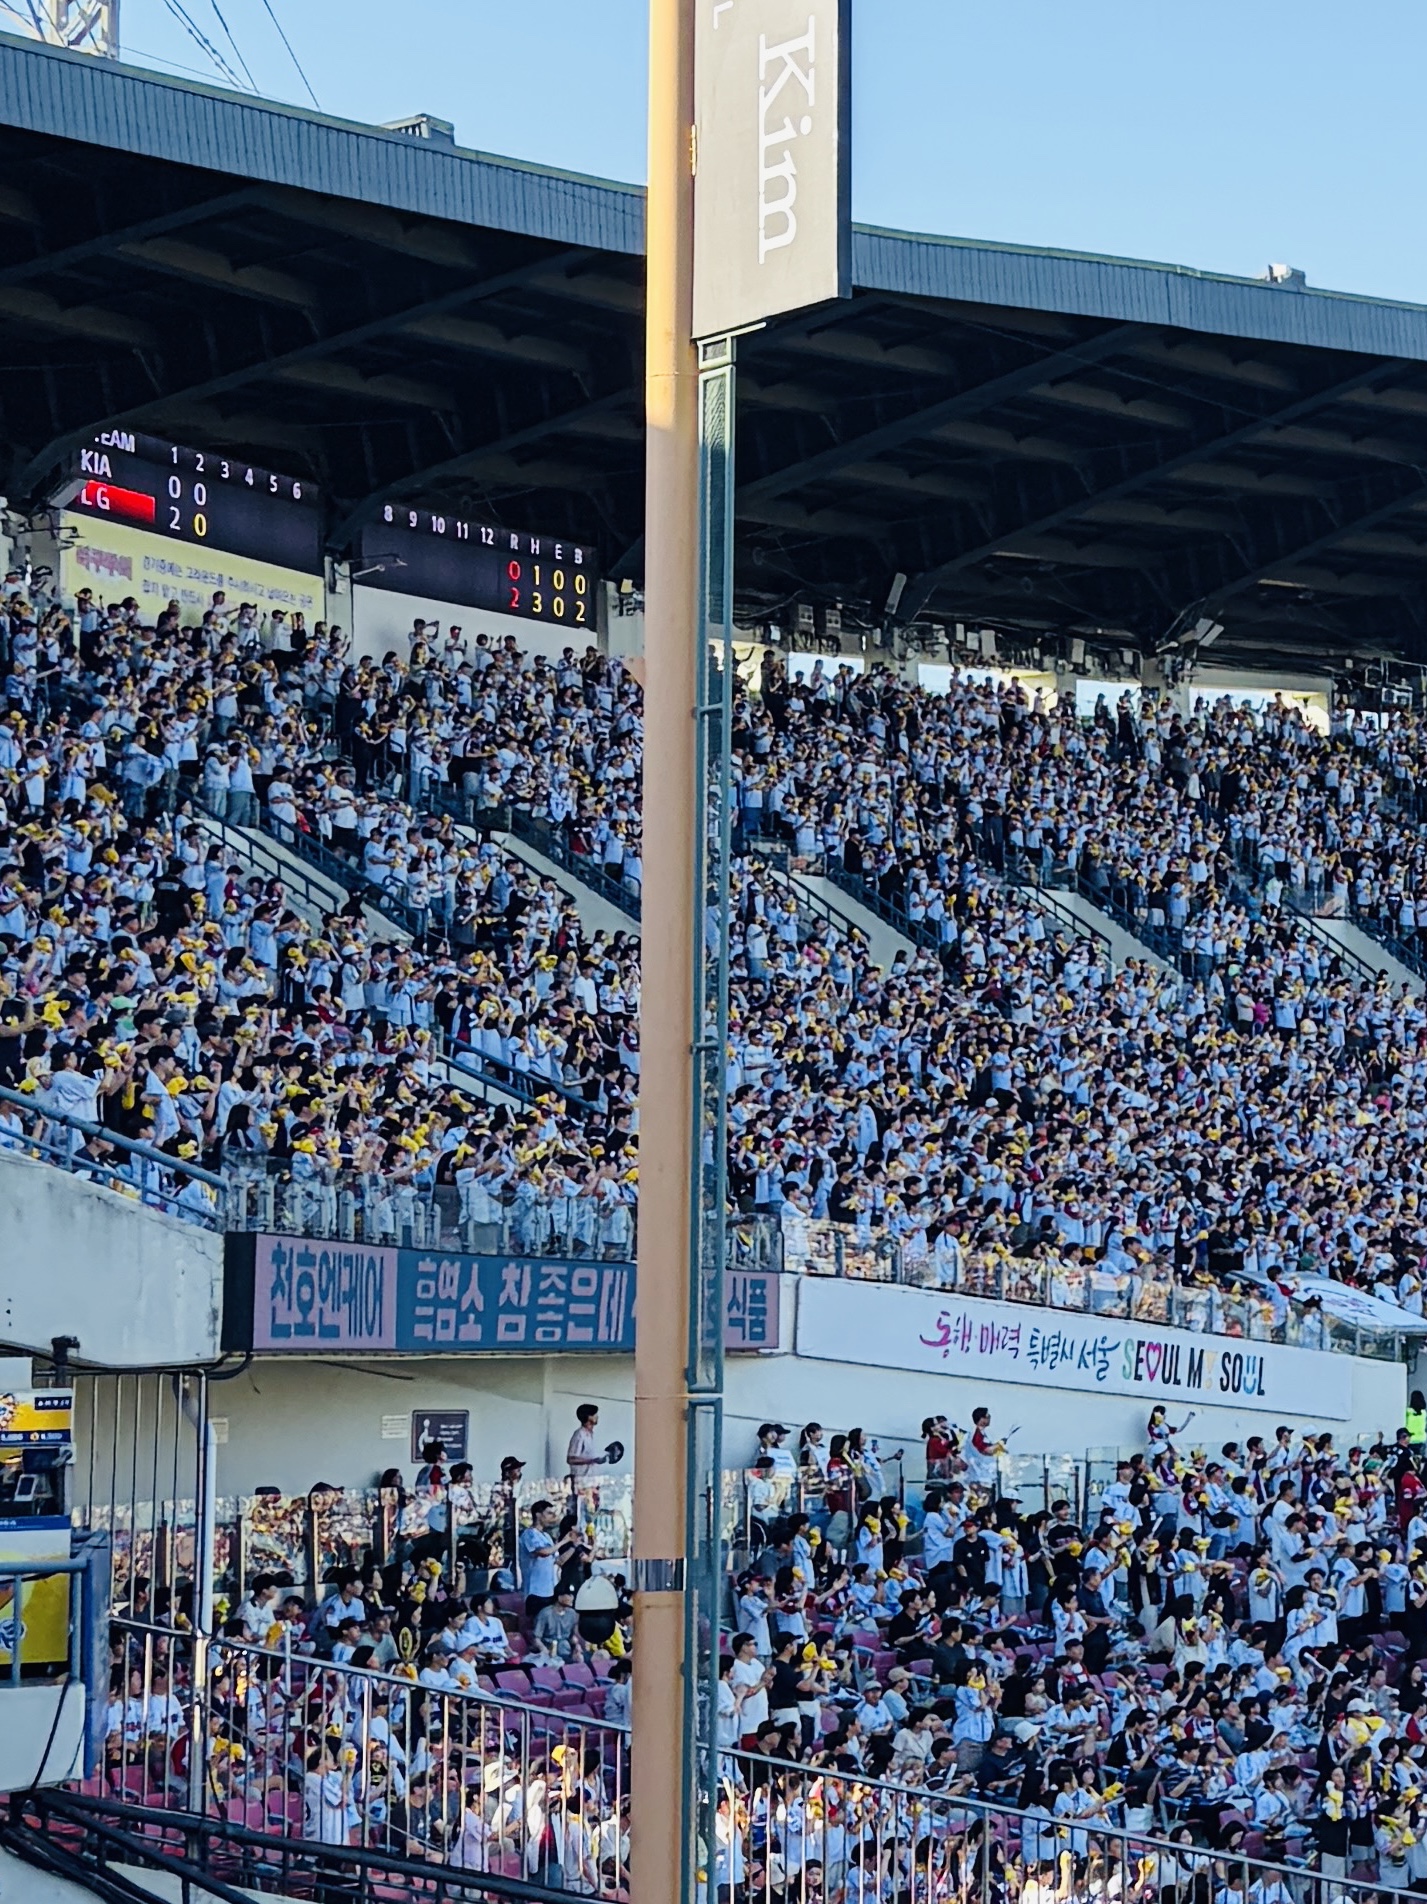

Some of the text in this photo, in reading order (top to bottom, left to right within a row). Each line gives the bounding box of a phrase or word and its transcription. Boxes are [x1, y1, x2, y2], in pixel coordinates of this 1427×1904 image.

[758, 15, 815, 265] Kim
[81, 449, 206, 506] KIA 0 0
[95, 430, 302, 499] EAM 1 2 3 4 5 6
[169, 506, 181, 530] 2
[194, 513, 207, 537] 0
[384, 505, 583, 564] 8 9 10 11 12 R H E B
[508, 560, 586, 595] 0 1 0 0
[510, 587, 585, 622] 2 3 0 2
[271, 1241, 384, 1339] 천호엔케어
[414, 1257, 628, 1342] 흑염소 참 좋은데
[1027, 1328, 1074, 1370] 특별시
[1078, 1336, 1121, 1381] 서울
[1220, 1352, 1265, 1396] SOUL
